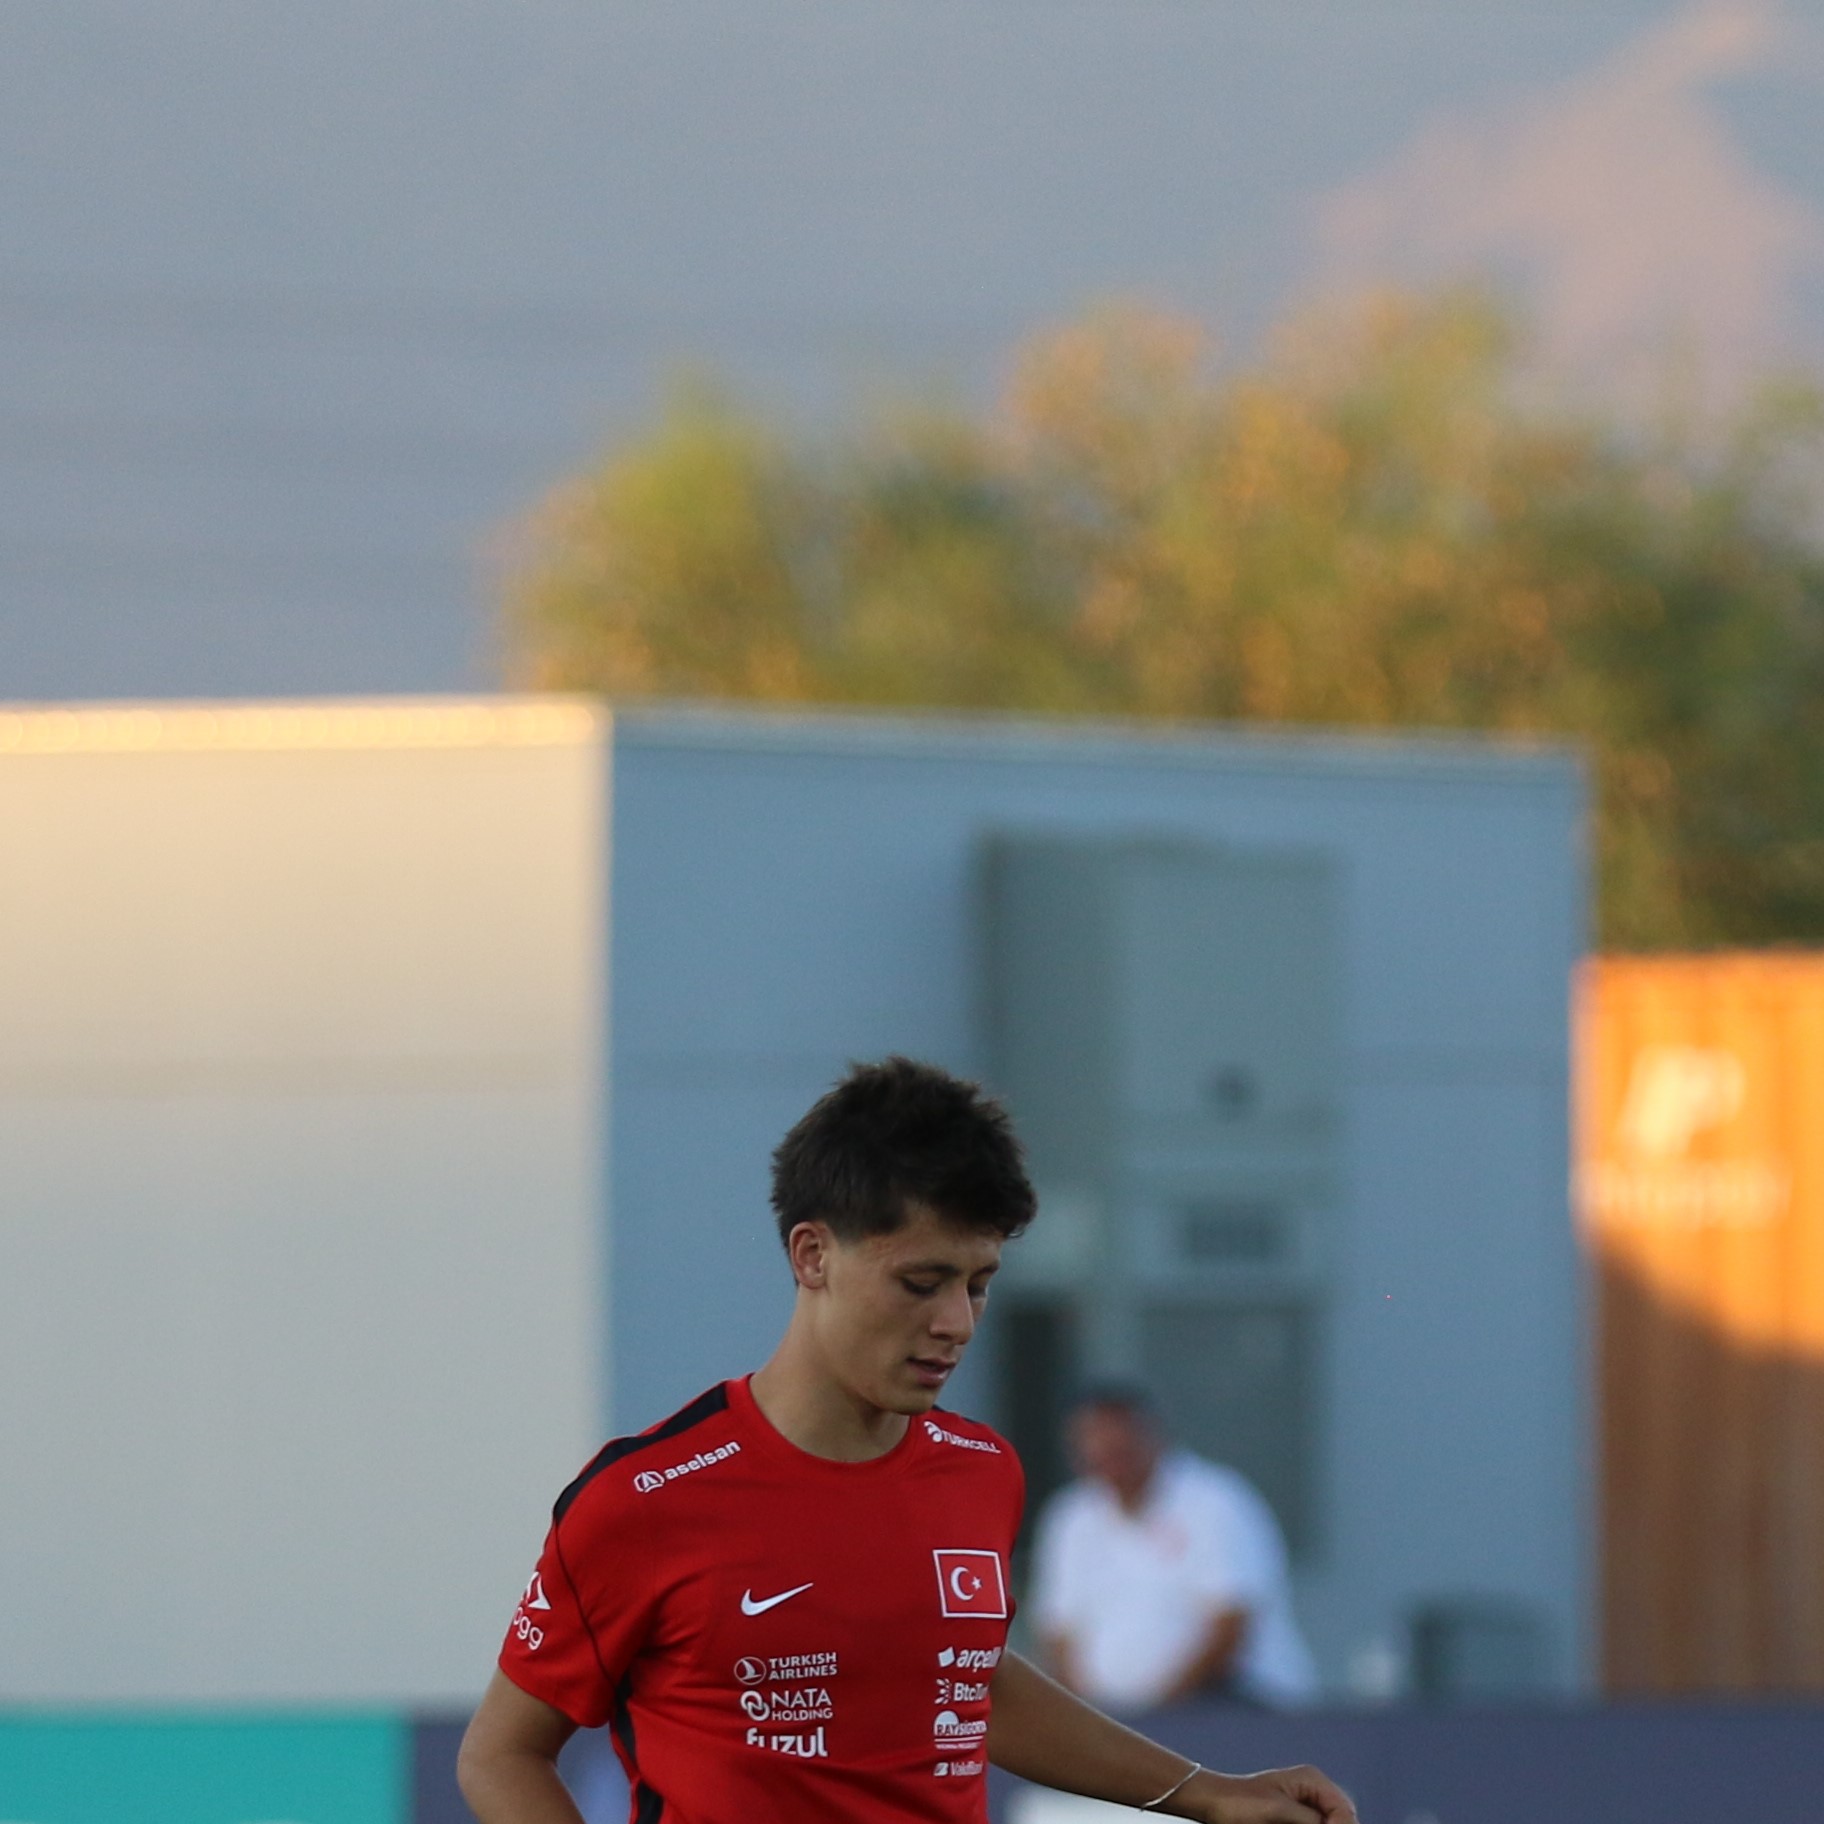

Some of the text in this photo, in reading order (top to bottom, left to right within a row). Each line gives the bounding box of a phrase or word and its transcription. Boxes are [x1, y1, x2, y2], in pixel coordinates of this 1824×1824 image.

[663, 1440, 742, 1480] aselsan
[768, 1650, 837, 1670] TURKISH
[768, 1663, 838, 1681] AIRLINES
[770, 1688, 833, 1709] NATA
[771, 1707, 834, 1721] HOLDING
